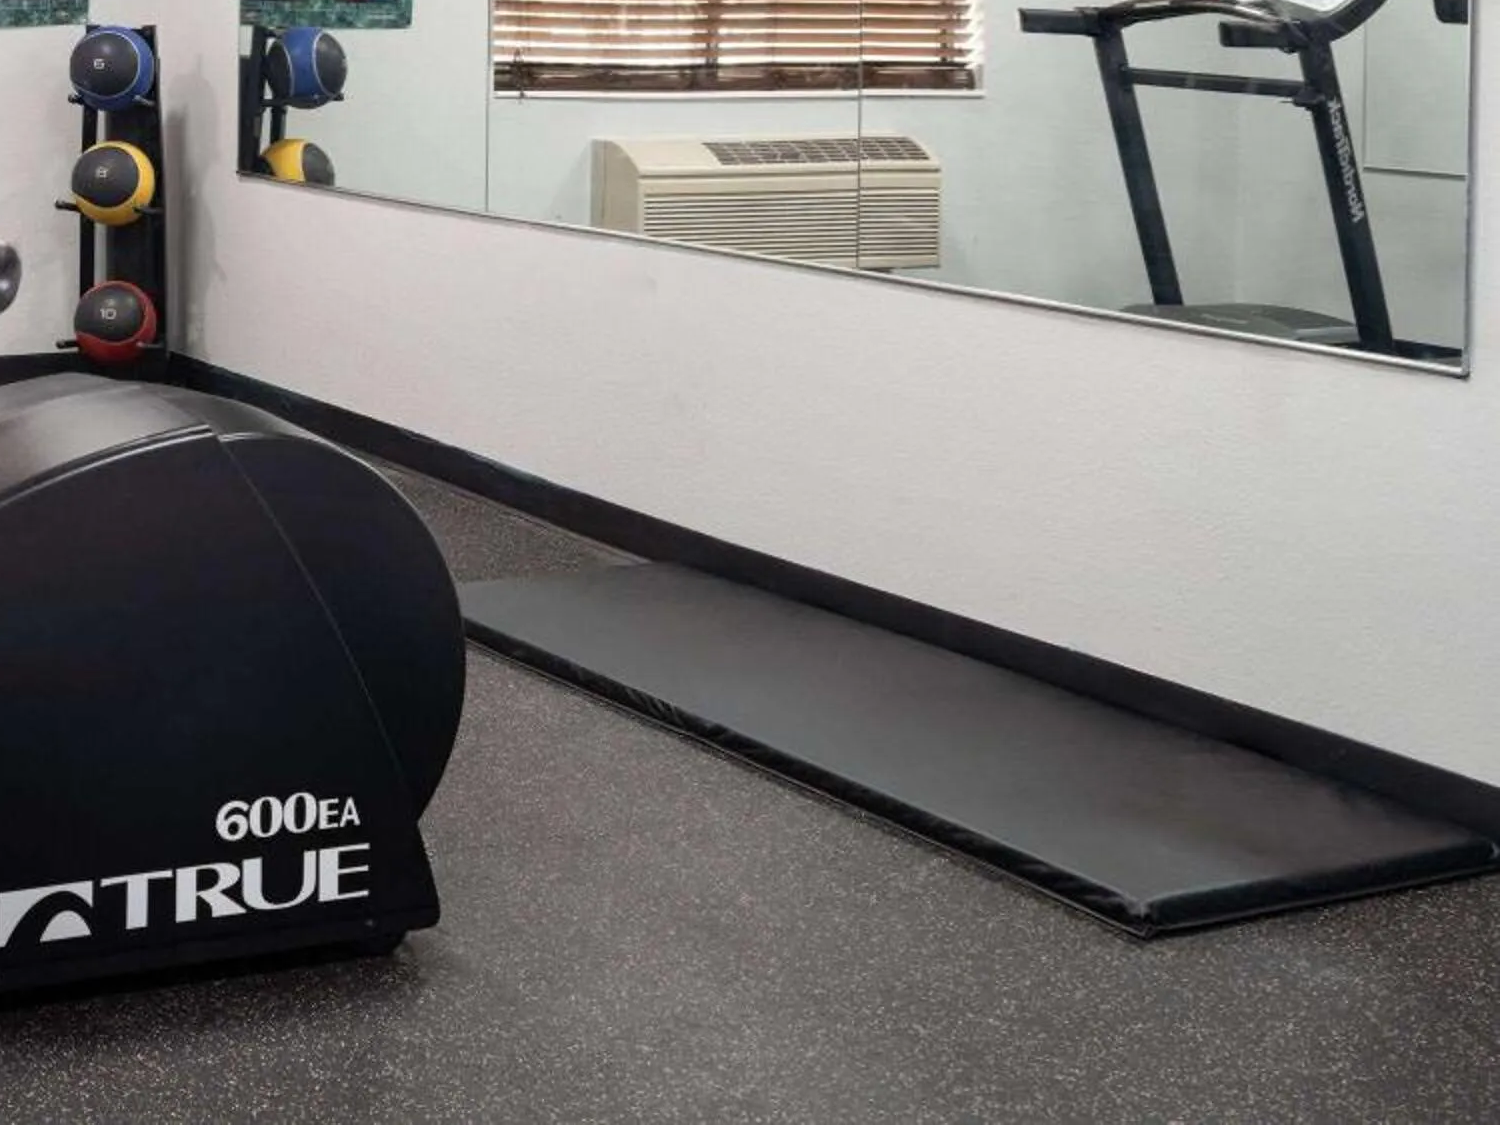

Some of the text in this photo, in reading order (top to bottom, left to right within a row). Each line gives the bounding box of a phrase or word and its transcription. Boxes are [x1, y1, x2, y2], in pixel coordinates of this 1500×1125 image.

[100, 307, 117, 320] 10
[215, 792, 361, 842] 600EA
[100, 842, 371, 930] TRUE
